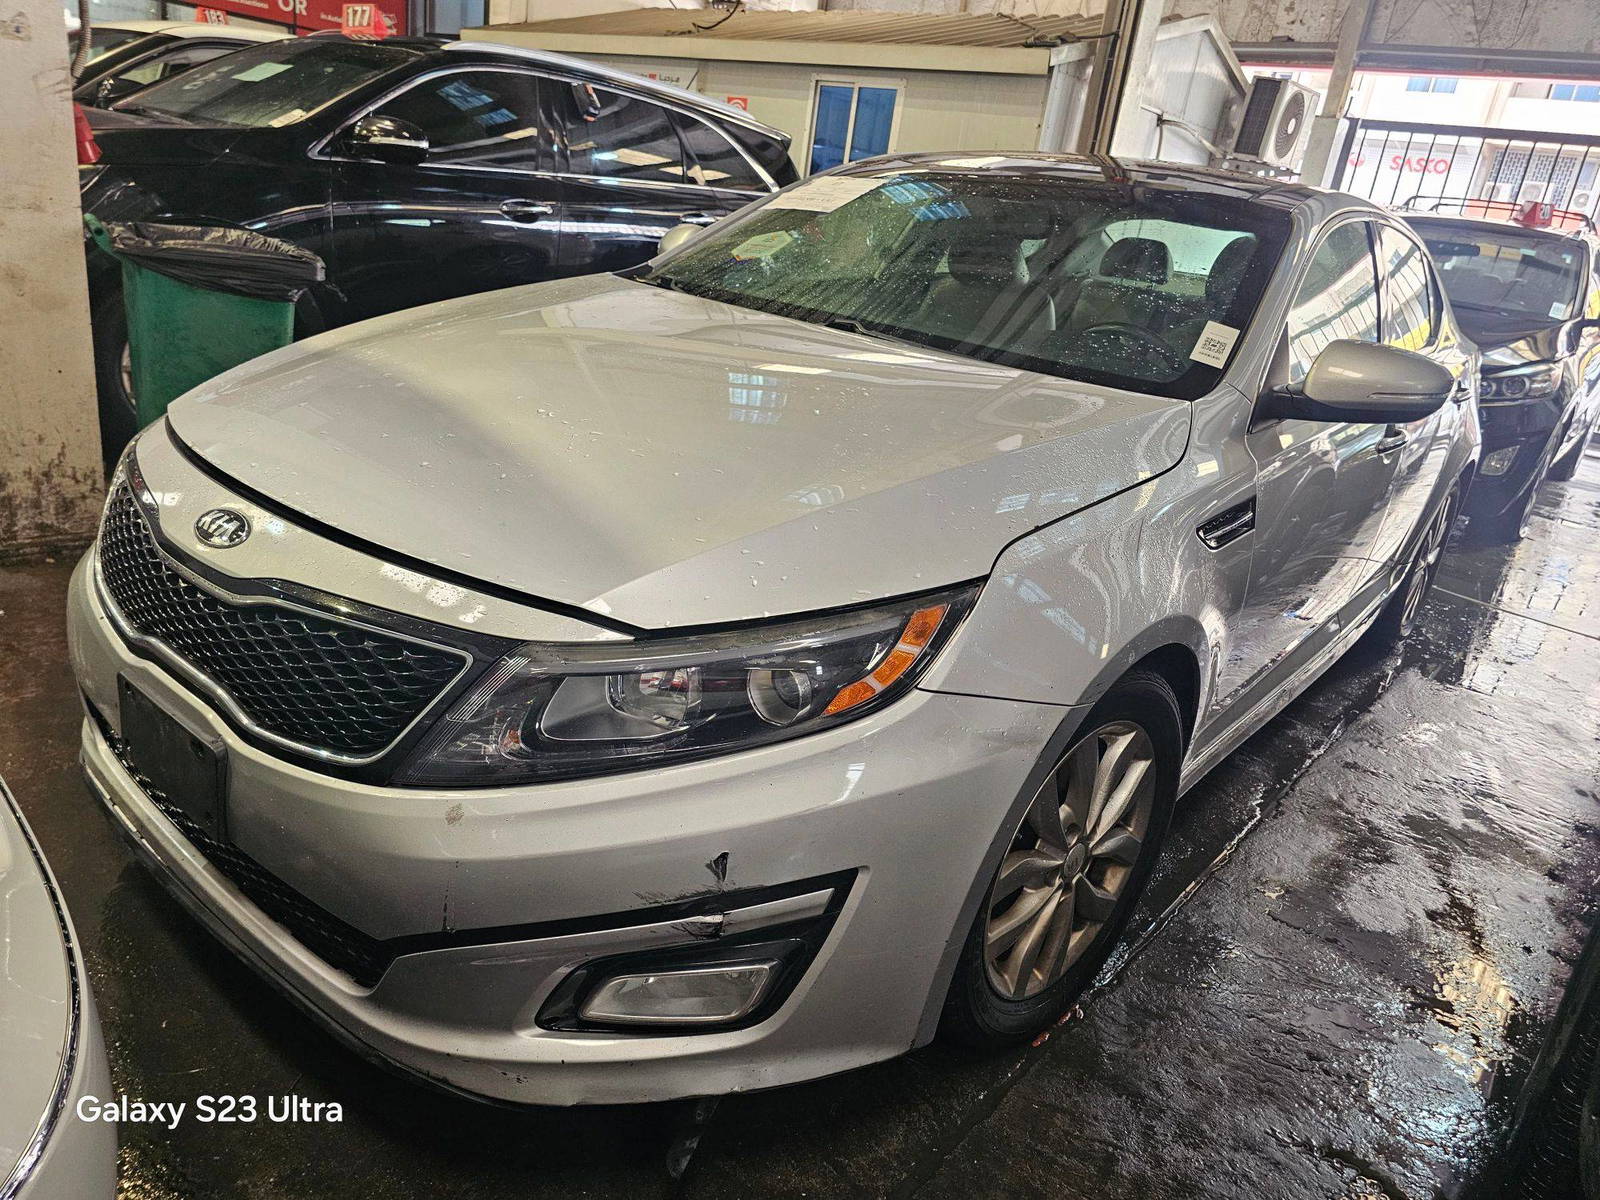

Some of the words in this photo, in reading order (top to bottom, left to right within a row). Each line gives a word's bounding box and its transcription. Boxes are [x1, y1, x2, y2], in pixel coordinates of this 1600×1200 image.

[346, 5, 370, 27] 177
[1390, 155, 1450, 174] SASCO
[197, 510, 241, 541] KIA
